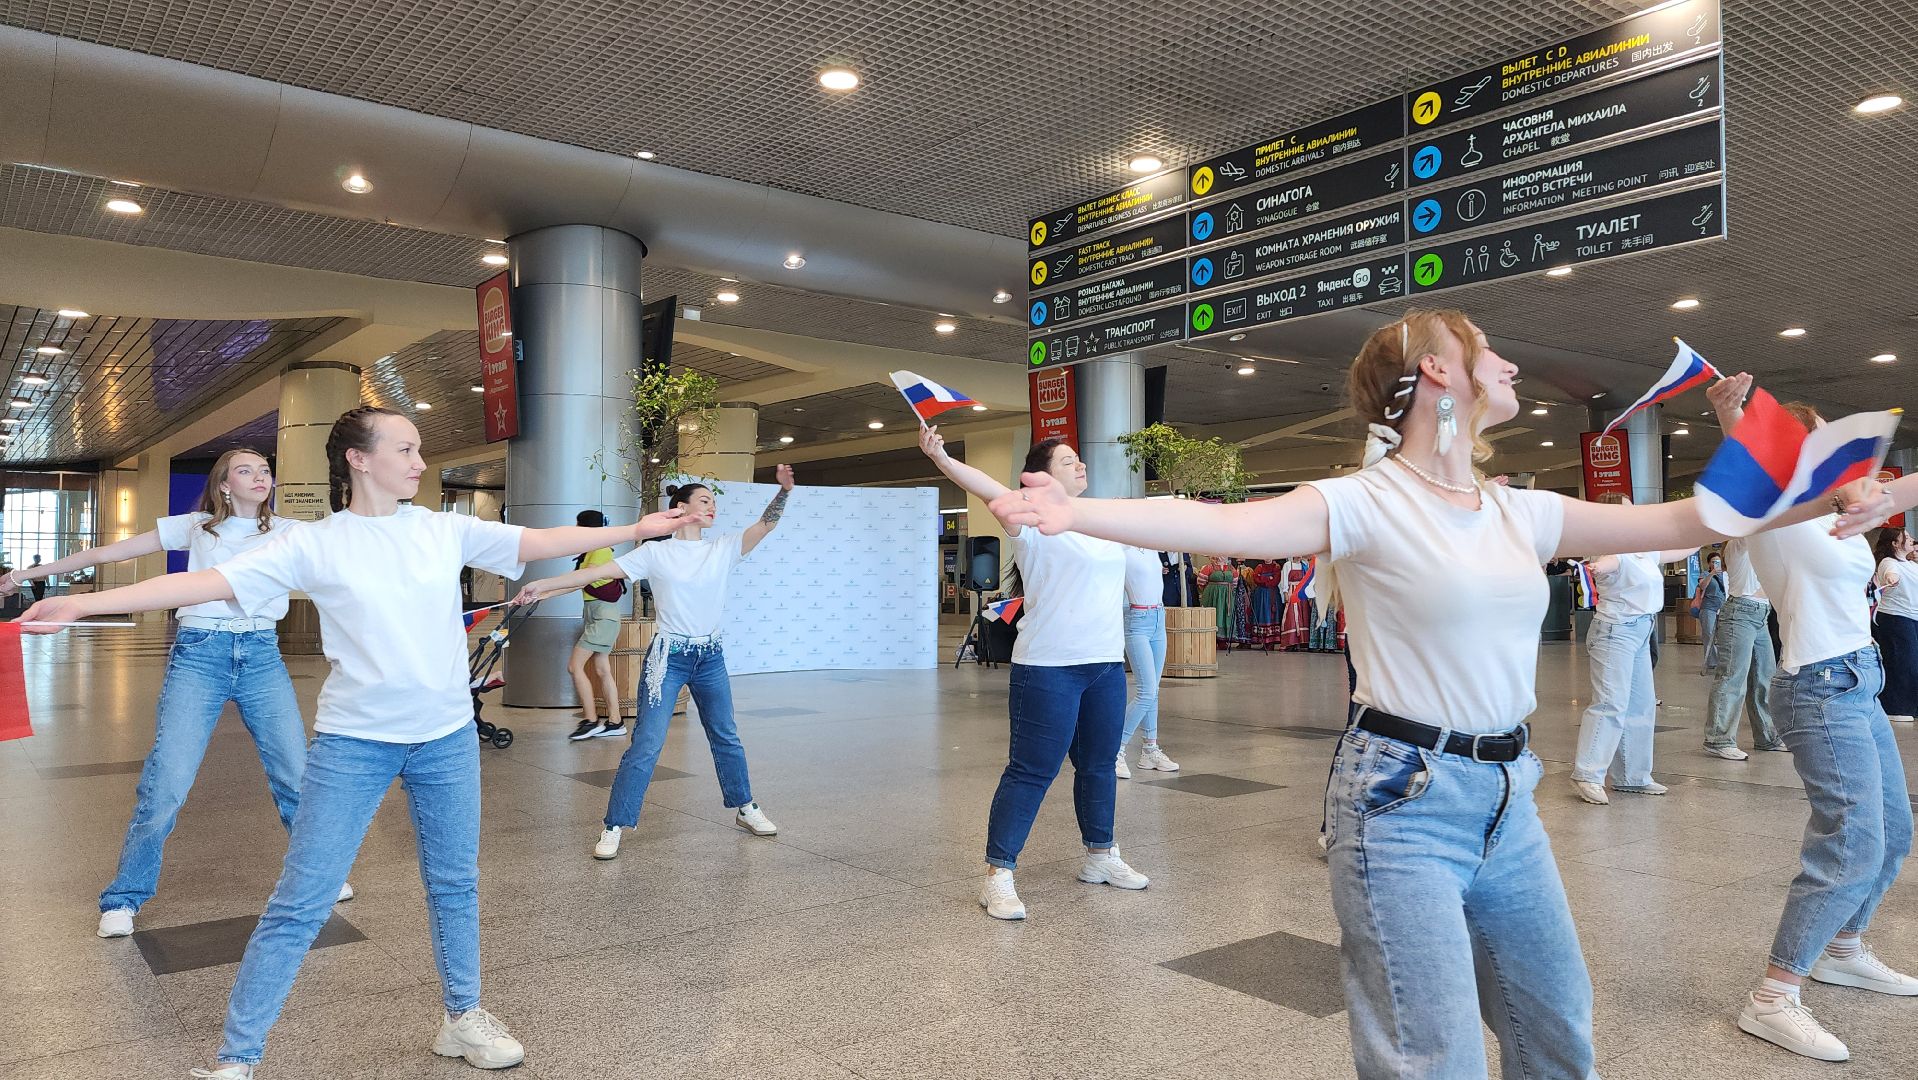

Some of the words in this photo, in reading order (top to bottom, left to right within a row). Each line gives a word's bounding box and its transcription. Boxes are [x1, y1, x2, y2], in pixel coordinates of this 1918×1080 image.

[1695, 36, 1701, 44] 2
[1502, 58, 1572, 88] ВНУТРЕННИЕ
[1575, 33, 1650, 65] АВИАЛИНИИ
[1502, 56, 1538, 75] ВЫЛЕТ
[1546, 50, 1553, 60] C
[1559, 47, 1567, 57] D
[1632, 41, 1674, 62] 国内出发
[1502, 78, 1551, 101] DOMESTIC
[1554, 57, 1619, 84] DEPARTURES
[1503, 110, 1553, 132] ЧАСОВНЯ
[1503, 120, 1565, 146] АРХАНГЕЛА
[1568, 104, 1627, 128] МИХАИЛА
[1256, 140, 1285, 156] ПРИЛЕТ
[1291, 136, 1296, 144] C
[1256, 144, 1304, 167] ВНУТРЕННИЕ
[1306, 127, 1357, 150] АВИАЛИНИИ
[1503, 141, 1540, 158] CHAPEL
[1256, 160, 1290, 177] DOMESTIC
[1291, 149, 1325, 166] ARRIVALS
[1503, 160, 1583, 189] ИНФОРМАЦИЯ
[1503, 185, 1539, 202] МЕСТО
[1542, 172, 1592, 192] ВСТРЕЧИ
[1503, 193, 1564, 214] INFORMATION
[1572, 182, 1614, 199] MEETING
[1618, 174, 1648, 188] POINT
[1078, 202, 1097, 214] ВЫЛЕТ
[1098, 194, 1120, 207] БИЗНЕС
[1121, 187, 1140, 200] КЛАСС
[1078, 206, 1114, 223] ВНУТРЕННИЕ
[1115, 193, 1152, 211] АВИАЛИНИИ
[1256, 185, 1313, 211] СИНАГОГА
[1078, 218, 1107, 233] DEPARTURES
[1108, 210, 1131, 223] BUSINESS
[1132, 205, 1147, 215] CLASS
[1256, 206, 1298, 226] SYNAGOGUE
[1256, 238, 1300, 258] КОМНАТА
[1302, 224, 1353, 247] ХРАНЕНИЯ
[1355, 212, 1399, 232] ОРУЖИЯ
[1576, 214, 1641, 240] ТУАЛЕТ
[1079, 246, 1091, 256] FAST
[1093, 240, 1110, 251] TRACK
[1079, 248, 1114, 265] ВНУТРЕННИЕ
[1116, 237, 1153, 254] АВИАЛИНИИ
[1576, 242, 1612, 257] TOILET
[1621, 234, 1653, 249] 洗手间
[1079, 261, 1104, 274] DOMESTIC
[1105, 258, 1117, 267] FAST
[1119, 252, 1135, 263] TRACK
[1256, 258, 1285, 272] WEAPON
[1286, 250, 1318, 264] STORAGE
[1320, 244, 1342, 257] ROOM
[1078, 285, 1100, 297] РОЗЫСК
[1102, 279, 1125, 291] БАГАЖА
[1317, 277, 1351, 293] Яндекс
[1354, 272, 1369, 285] Go
[1078, 291, 1114, 306] ВНУТРЕННИЕ
[1116, 281, 1153, 297] АВИАЛИНИИ
[1257, 287, 1297, 306] ВЫХОД
[1300, 285, 1306, 298] 2
[1317, 298, 1334, 308] TAXI
[485, 306, 504, 323] BURGER
[1079, 302, 1104, 316] DOMESTIC
[1226, 305, 1242, 316] EXIT
[1257, 310, 1272, 320] EXIT
[486, 318, 504, 342] KING
[1105, 319, 1156, 339] ТРАНСПОРТ
[1104, 340, 1122, 350] PUBLIC
[1123, 334, 1155, 346] TRANSPORT
[1039, 378, 1064, 390] BURGER
[1040, 387, 1065, 403] KING
[1592, 452, 1619, 461] KING
[947, 520, 955, 530] 64
